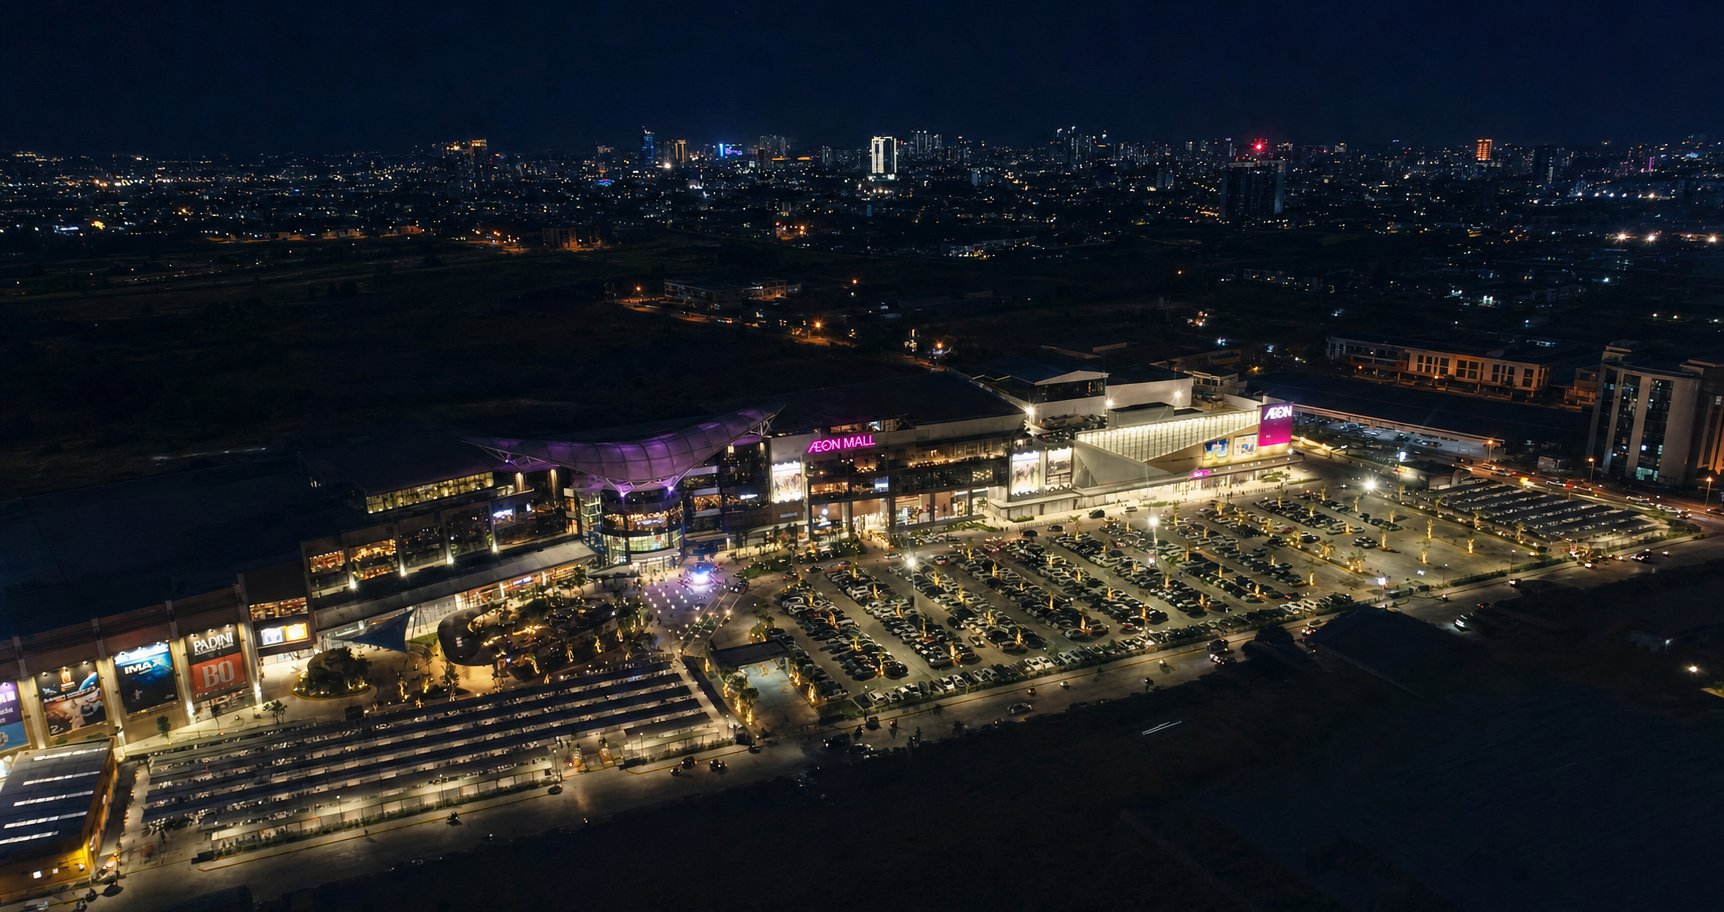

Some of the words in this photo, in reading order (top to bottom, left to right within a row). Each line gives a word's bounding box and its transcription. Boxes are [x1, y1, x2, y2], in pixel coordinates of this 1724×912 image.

[843, 435, 876, 448] MALL
[193, 632, 233, 653] PADINI
[124, 659, 161, 674] IMAX
[202, 660, 235, 688] BO
